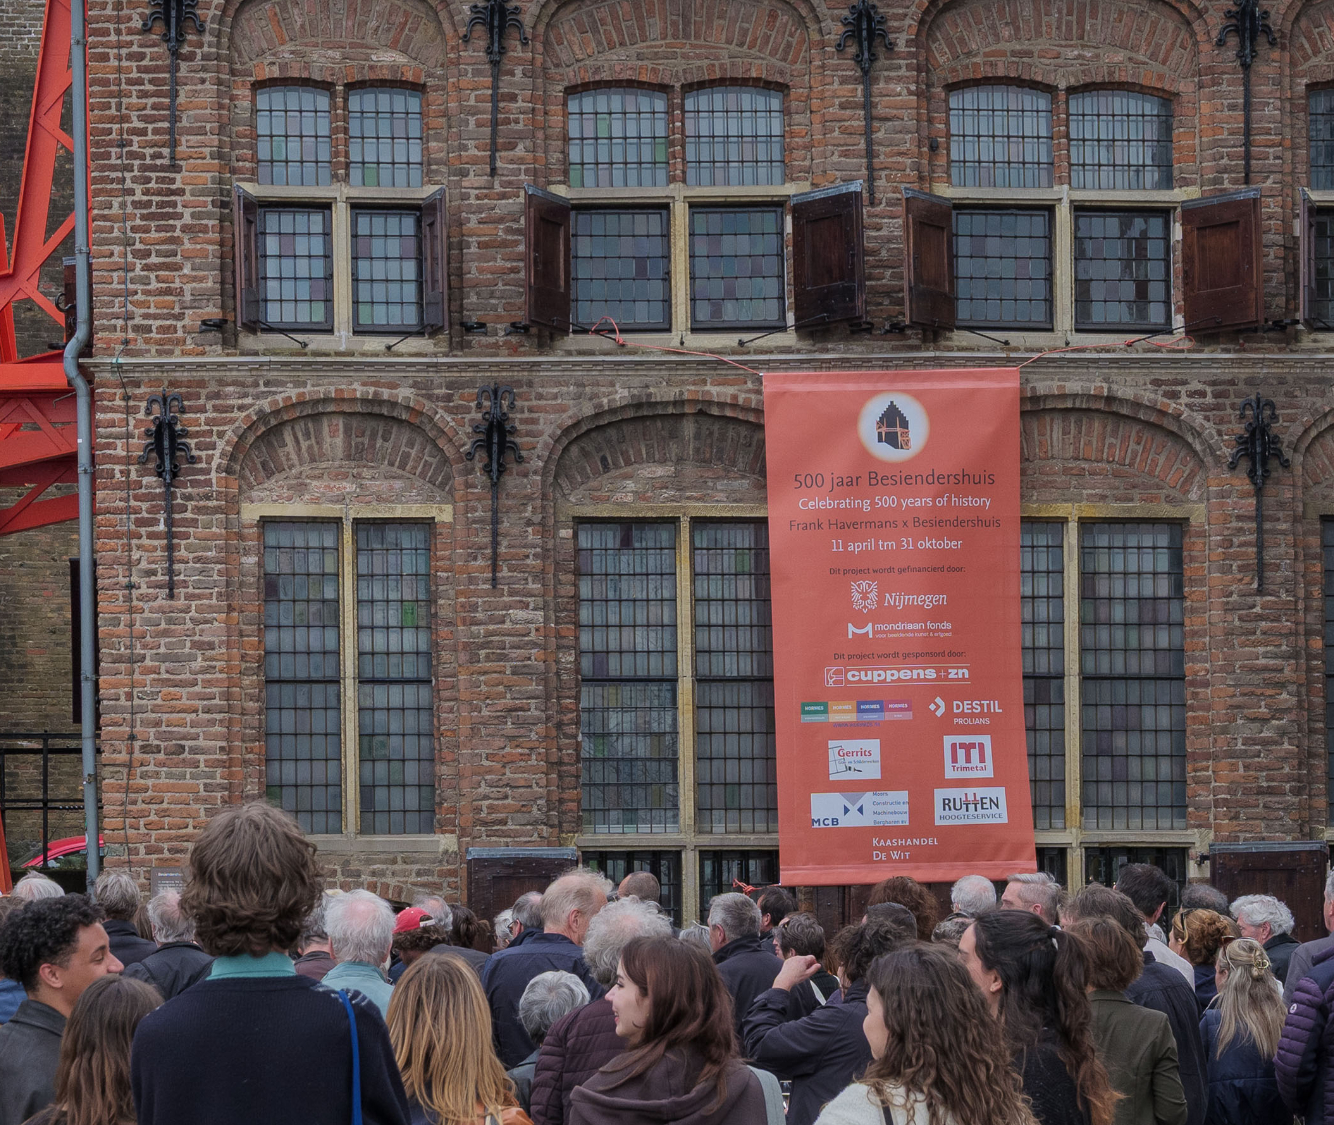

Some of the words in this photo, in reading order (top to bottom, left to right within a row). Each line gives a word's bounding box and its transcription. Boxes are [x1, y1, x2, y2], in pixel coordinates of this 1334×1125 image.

[794, 473, 825, 489] 500
[829, 472, 862, 492] jaar
[868, 468, 995, 486] Besiendershuis
[798, 496, 871, 512] Celebrating
[875, 495, 897, 508] 500
[901, 496, 933, 510] years
[935, 493, 949, 507] of
[951, 493, 991, 510] history
[789, 518, 824, 531] Frank
[828, 518, 898, 530] Havermans
[902, 520, 909, 528] x
[913, 516, 1001, 528] Besiendershuis
[831, 539, 844, 552] 11
[847, 538, 875, 555] april
[878, 539, 896, 550] tm
[900, 537, 914, 550] 31
[917, 536, 963, 549] oktober
[829, 567, 841, 575] Dit
[842, 567, 870, 576] project
[872, 566, 895, 574] wordt
[897, 565, 945, 575] gefinancierd
[946, 565, 966, 573] door:
[884, 592, 947, 610] Nijmegen
[875, 621, 925, 631] mondriaan
[926, 621, 952, 630] fonds
[833, 652, 845, 660] Dit
[847, 652, 875, 661] project
[877, 651, 900, 659] wordt
[902, 650, 946, 660] gesponsord
[947, 650, 966, 658] door:
[952, 700, 1003, 713] DESTIL
[837, 747, 872, 758] Gerrits
[942, 792, 999, 812] RUTTEN
[812, 818, 839, 826] MCB
[939, 812, 1003, 821] HOOGTESERVICE
[872, 837, 939, 847] KAASHANDEL
